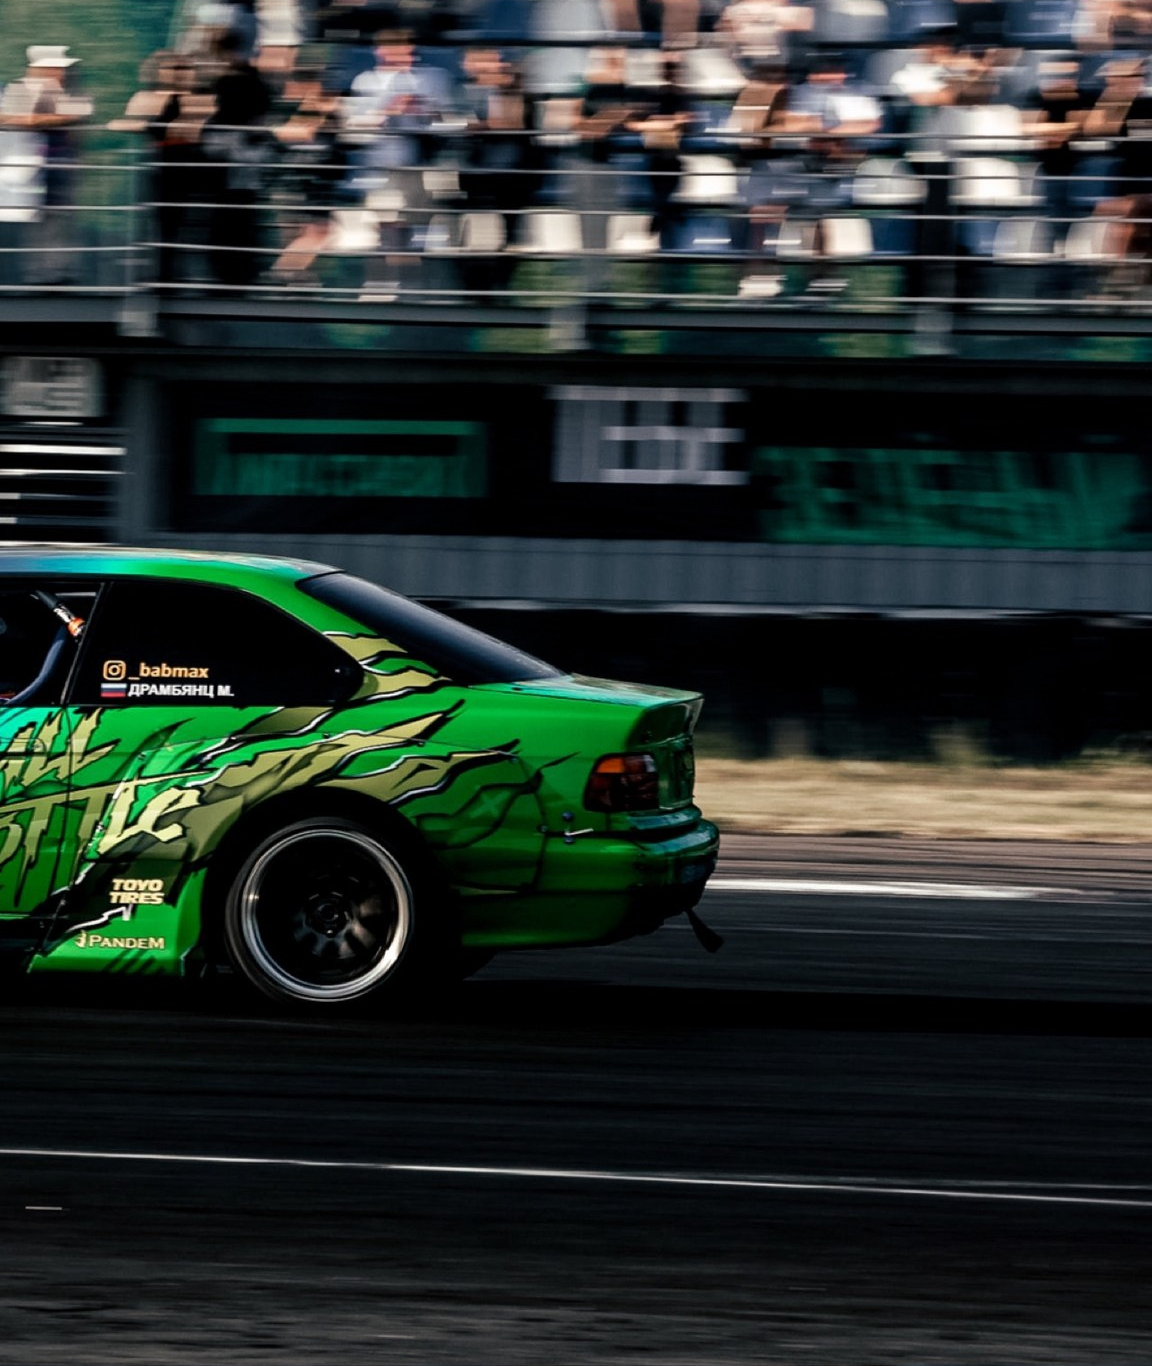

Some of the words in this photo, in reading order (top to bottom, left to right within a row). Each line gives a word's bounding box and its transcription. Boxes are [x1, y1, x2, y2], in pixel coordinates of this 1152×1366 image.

[128, 662, 209, 680] _babmax
[128, 683, 214, 698] ДРАМБЯНЦ
[217, 685, 234, 697] М.
[111, 878, 164, 892] TOYO
[109, 891, 166, 905] TIRES
